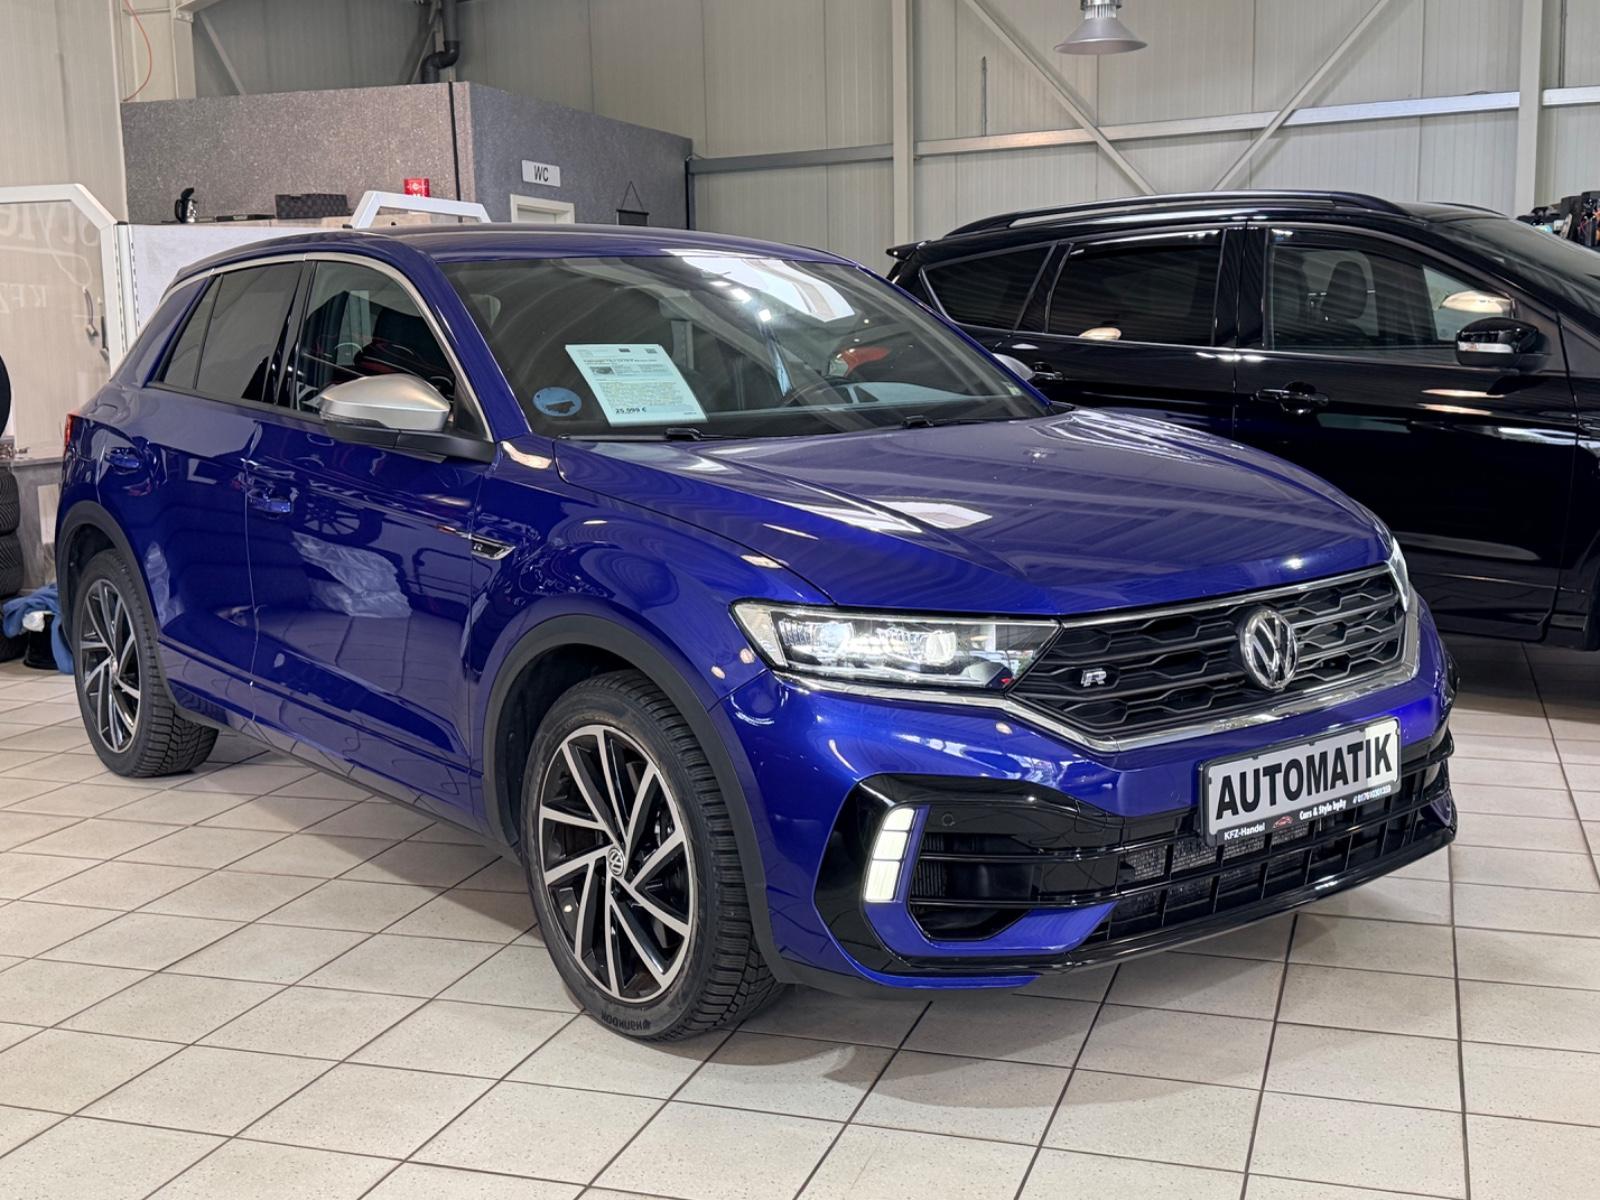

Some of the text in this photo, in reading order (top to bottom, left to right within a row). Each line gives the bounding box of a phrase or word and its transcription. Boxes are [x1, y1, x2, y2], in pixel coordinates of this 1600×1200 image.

[534, 165, 549, 182] WC
[1081, 668, 1107, 687] R
[1215, 733, 1392, 820] AUTOMATIK
[1223, 822, 1266, 841] KFZ-Handel
[1313, 805, 1319, 817] &
[1319, 802, 1332, 817] Style
